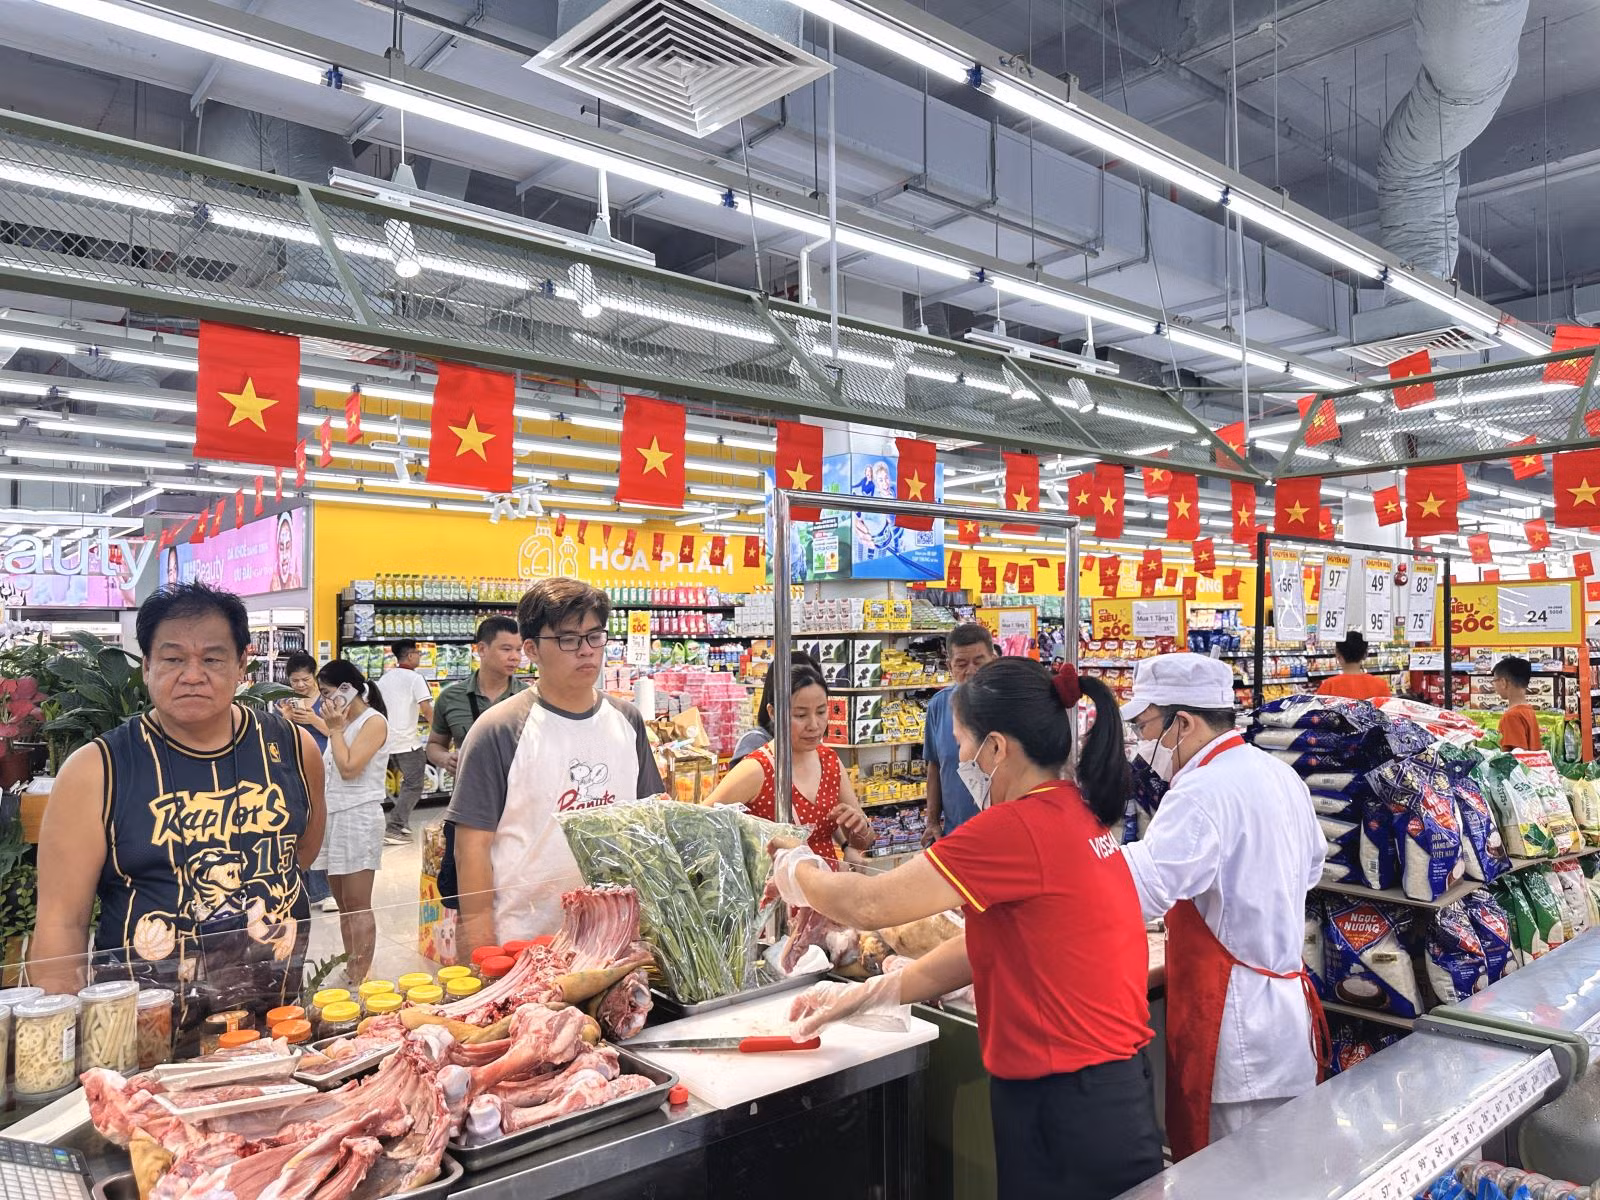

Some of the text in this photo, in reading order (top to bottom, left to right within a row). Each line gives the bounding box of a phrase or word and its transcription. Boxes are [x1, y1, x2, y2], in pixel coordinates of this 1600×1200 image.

[1329, 570, 1341, 588] 97
[1372, 575, 1384, 592] 49
[1417, 577, 1428, 593] 83
[1325, 610, 1337, 628] 85
[1371, 614, 1383, 630] 95
[1413, 614, 1424, 629] 75
[1527, 610, 1548, 623] 24
[1103, 620, 1131, 637] SỐC
[1418, 655, 1433, 665] 27
[252, 835, 297, 878] 15
[1350, 912, 1378, 923] NGỌC
